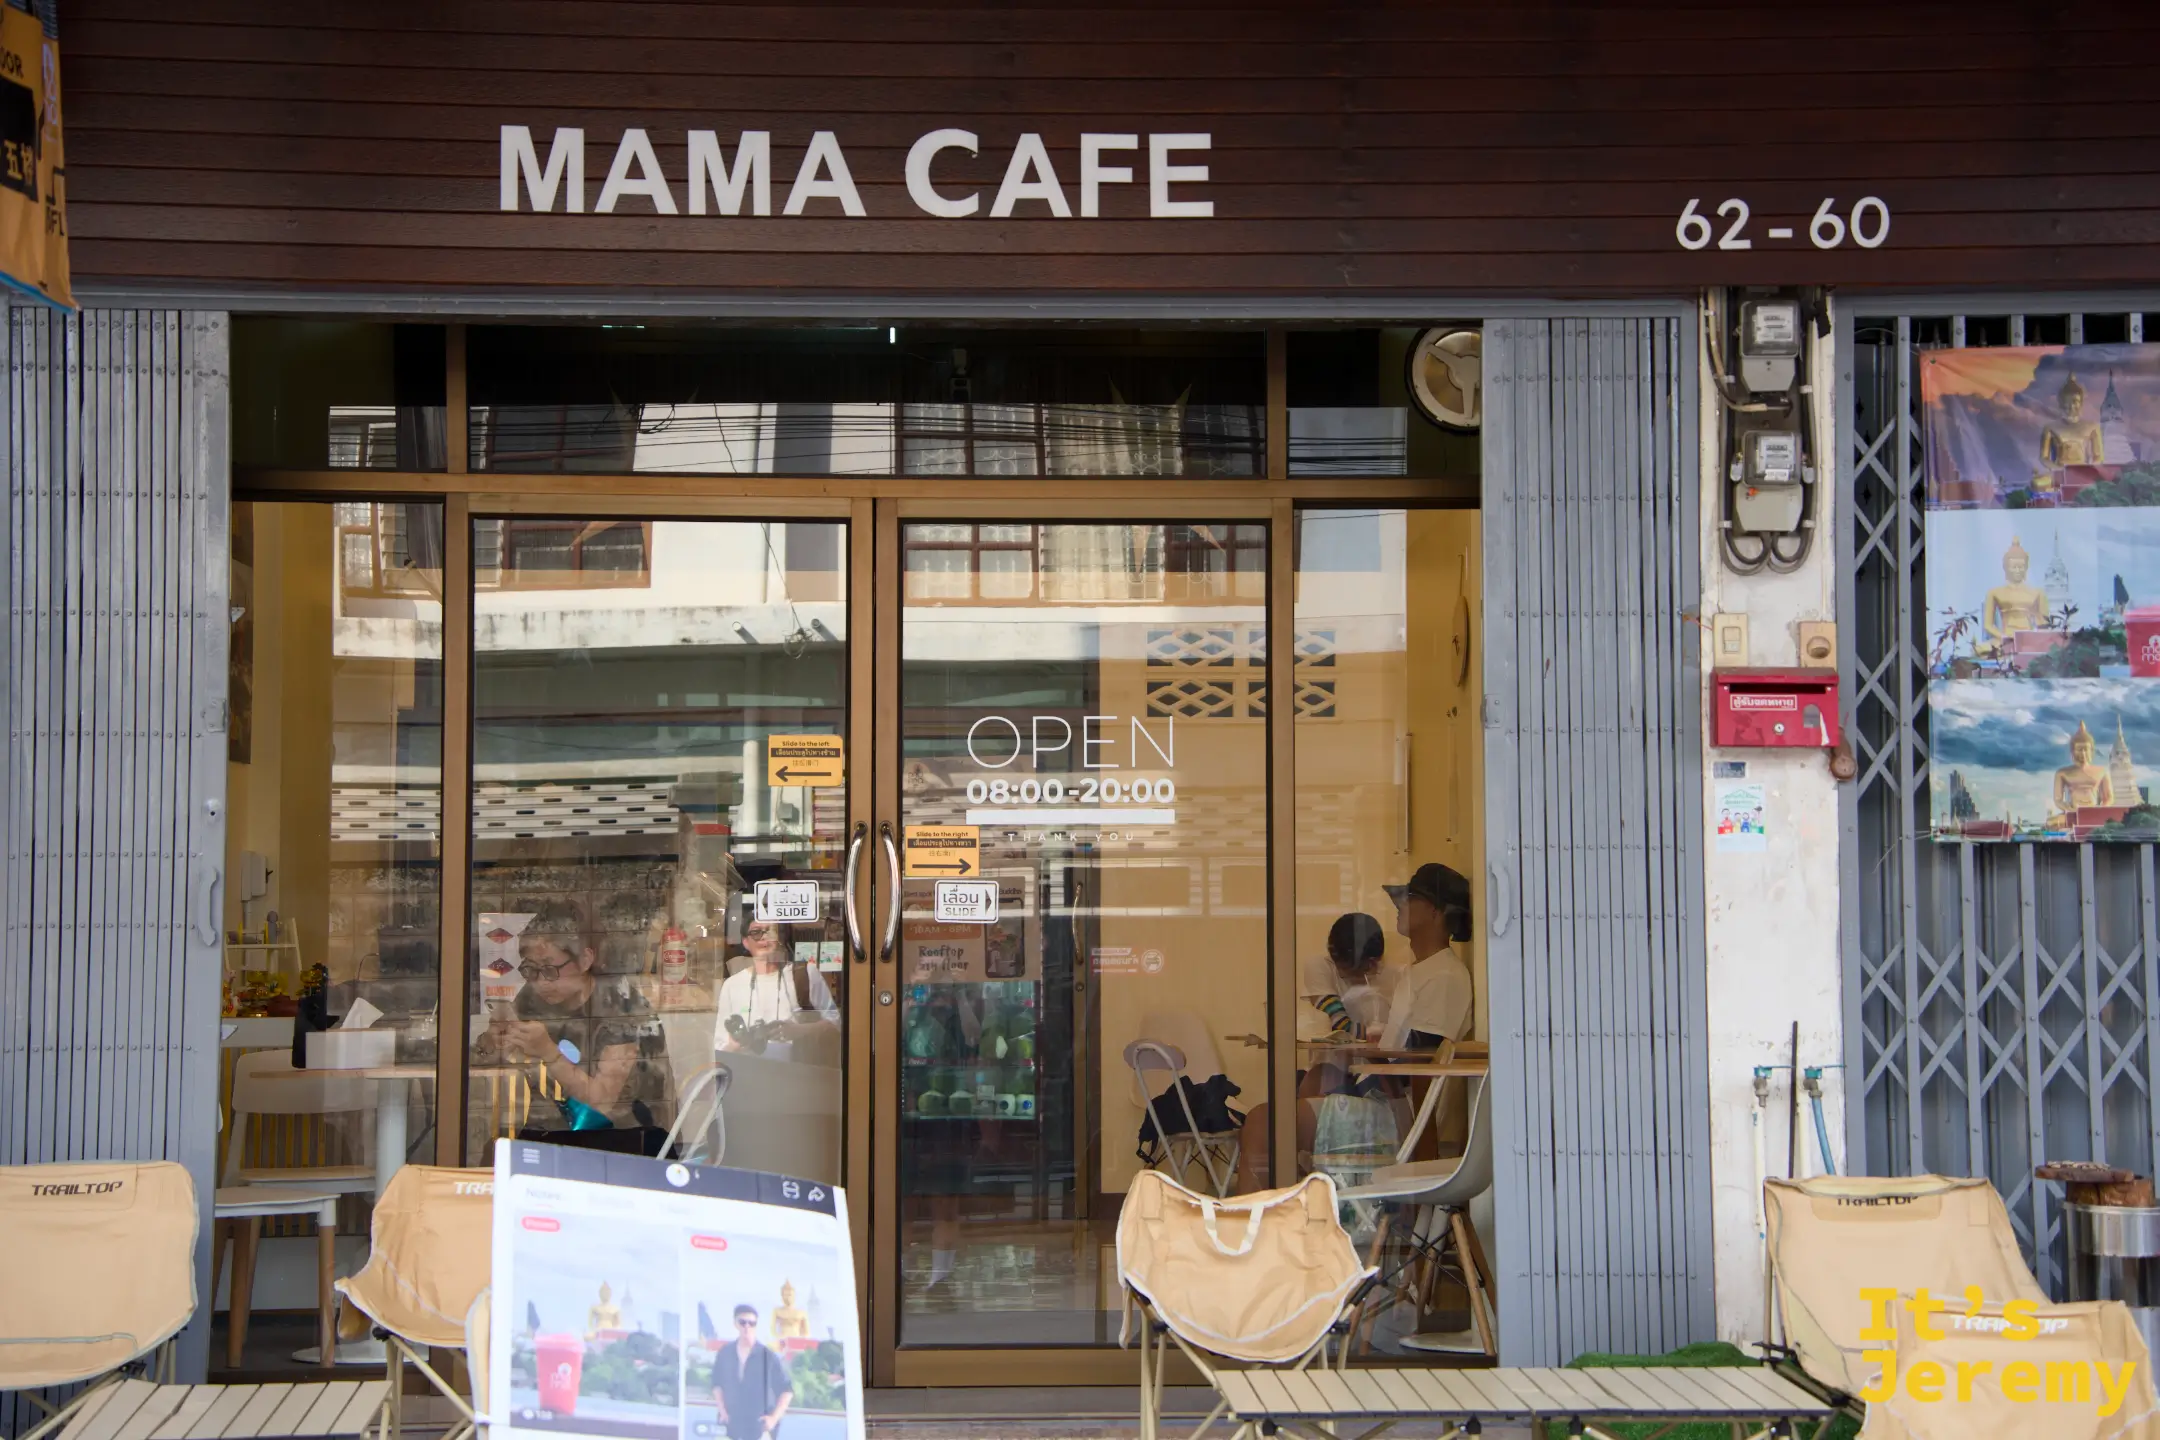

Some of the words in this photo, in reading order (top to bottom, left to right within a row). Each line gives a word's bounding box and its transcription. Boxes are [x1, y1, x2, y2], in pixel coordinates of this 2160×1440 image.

[499, 124, 867, 217] MAMA
[904, 127, 1216, 219] CAFE
[967, 715, 1174, 769] OPEN
[966, 777, 1175, 804] 08:00-20:00
[952, 831, 969, 839] right
[1007, 832, 1078, 842] THANK
[1095, 832, 1135, 842] YOU
[943, 884, 979, 904] เลื่อน
[775, 907, 808, 917] SLIDE
[945, 907, 977, 916] SLIDE
[918, 944, 965, 961] Rooftop
[31, 1180, 124, 1197] TRAILTOP
